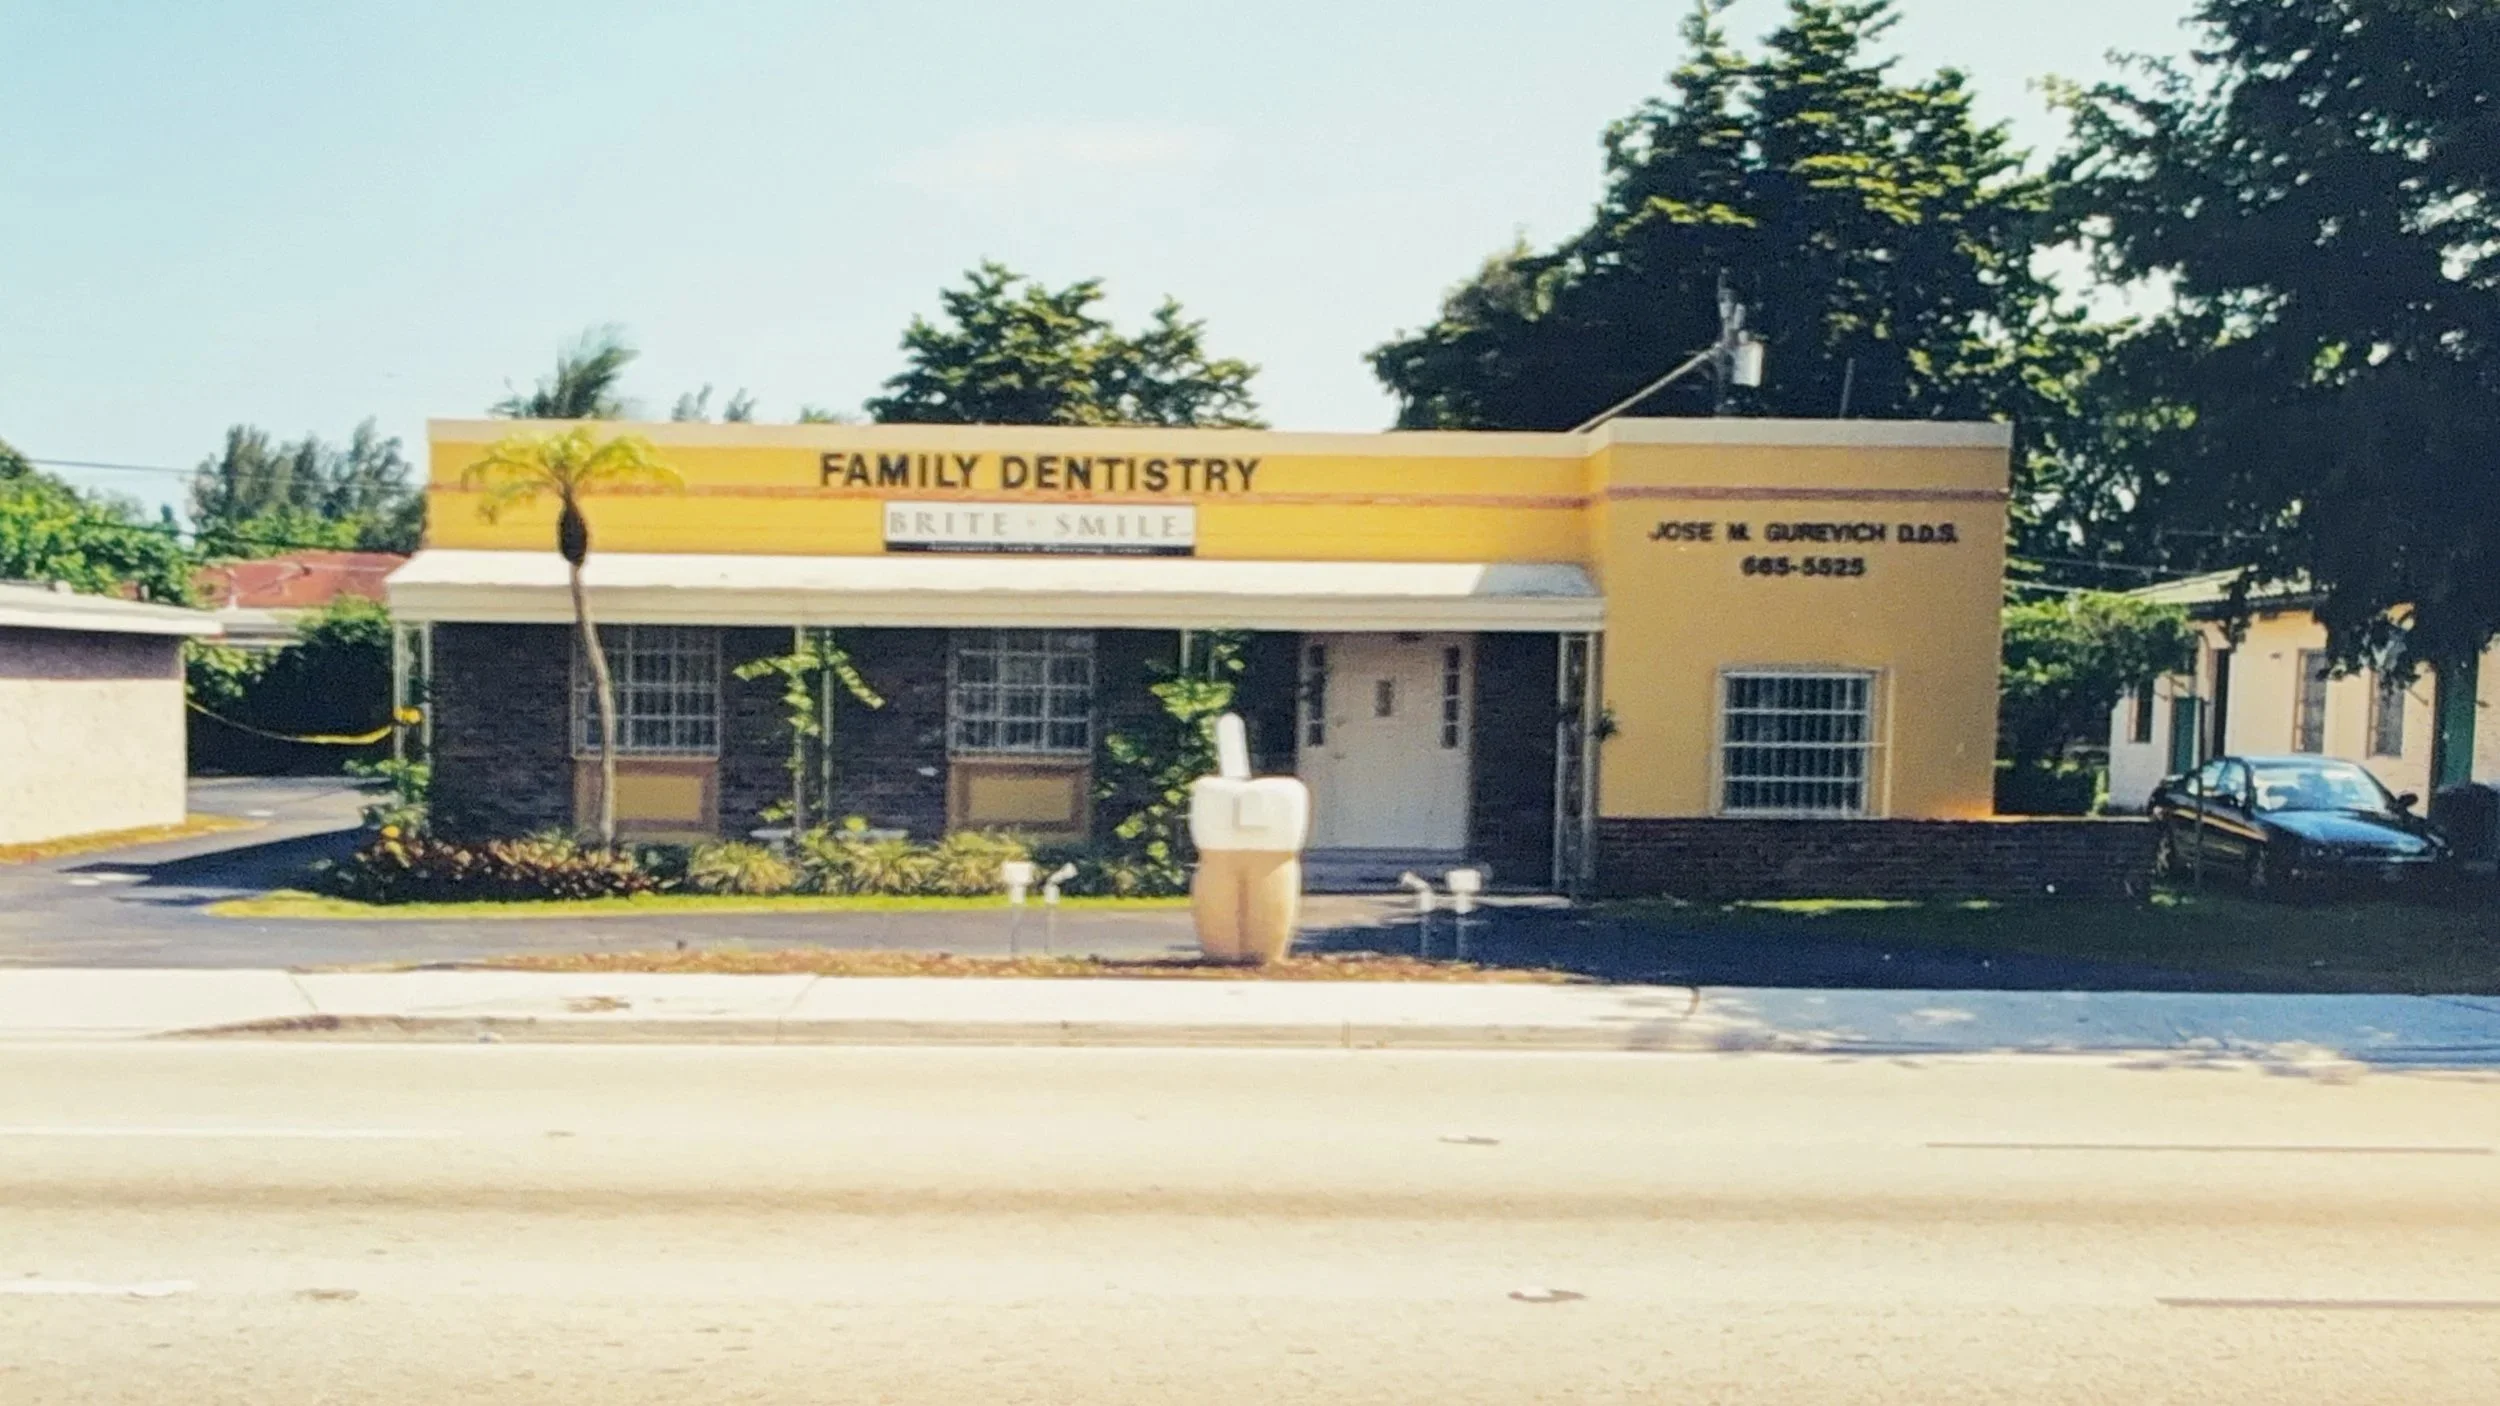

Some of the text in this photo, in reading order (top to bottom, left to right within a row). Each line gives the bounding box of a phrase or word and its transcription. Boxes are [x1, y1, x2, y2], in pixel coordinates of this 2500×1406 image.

[820, 453, 1260, 491] FAMILY DENTISTRY
[889, 511, 1182, 538] BRITE SMILE
[1650, 521, 1713, 541] JOSE
[1765, 523, 1885, 543] GUREVICH
